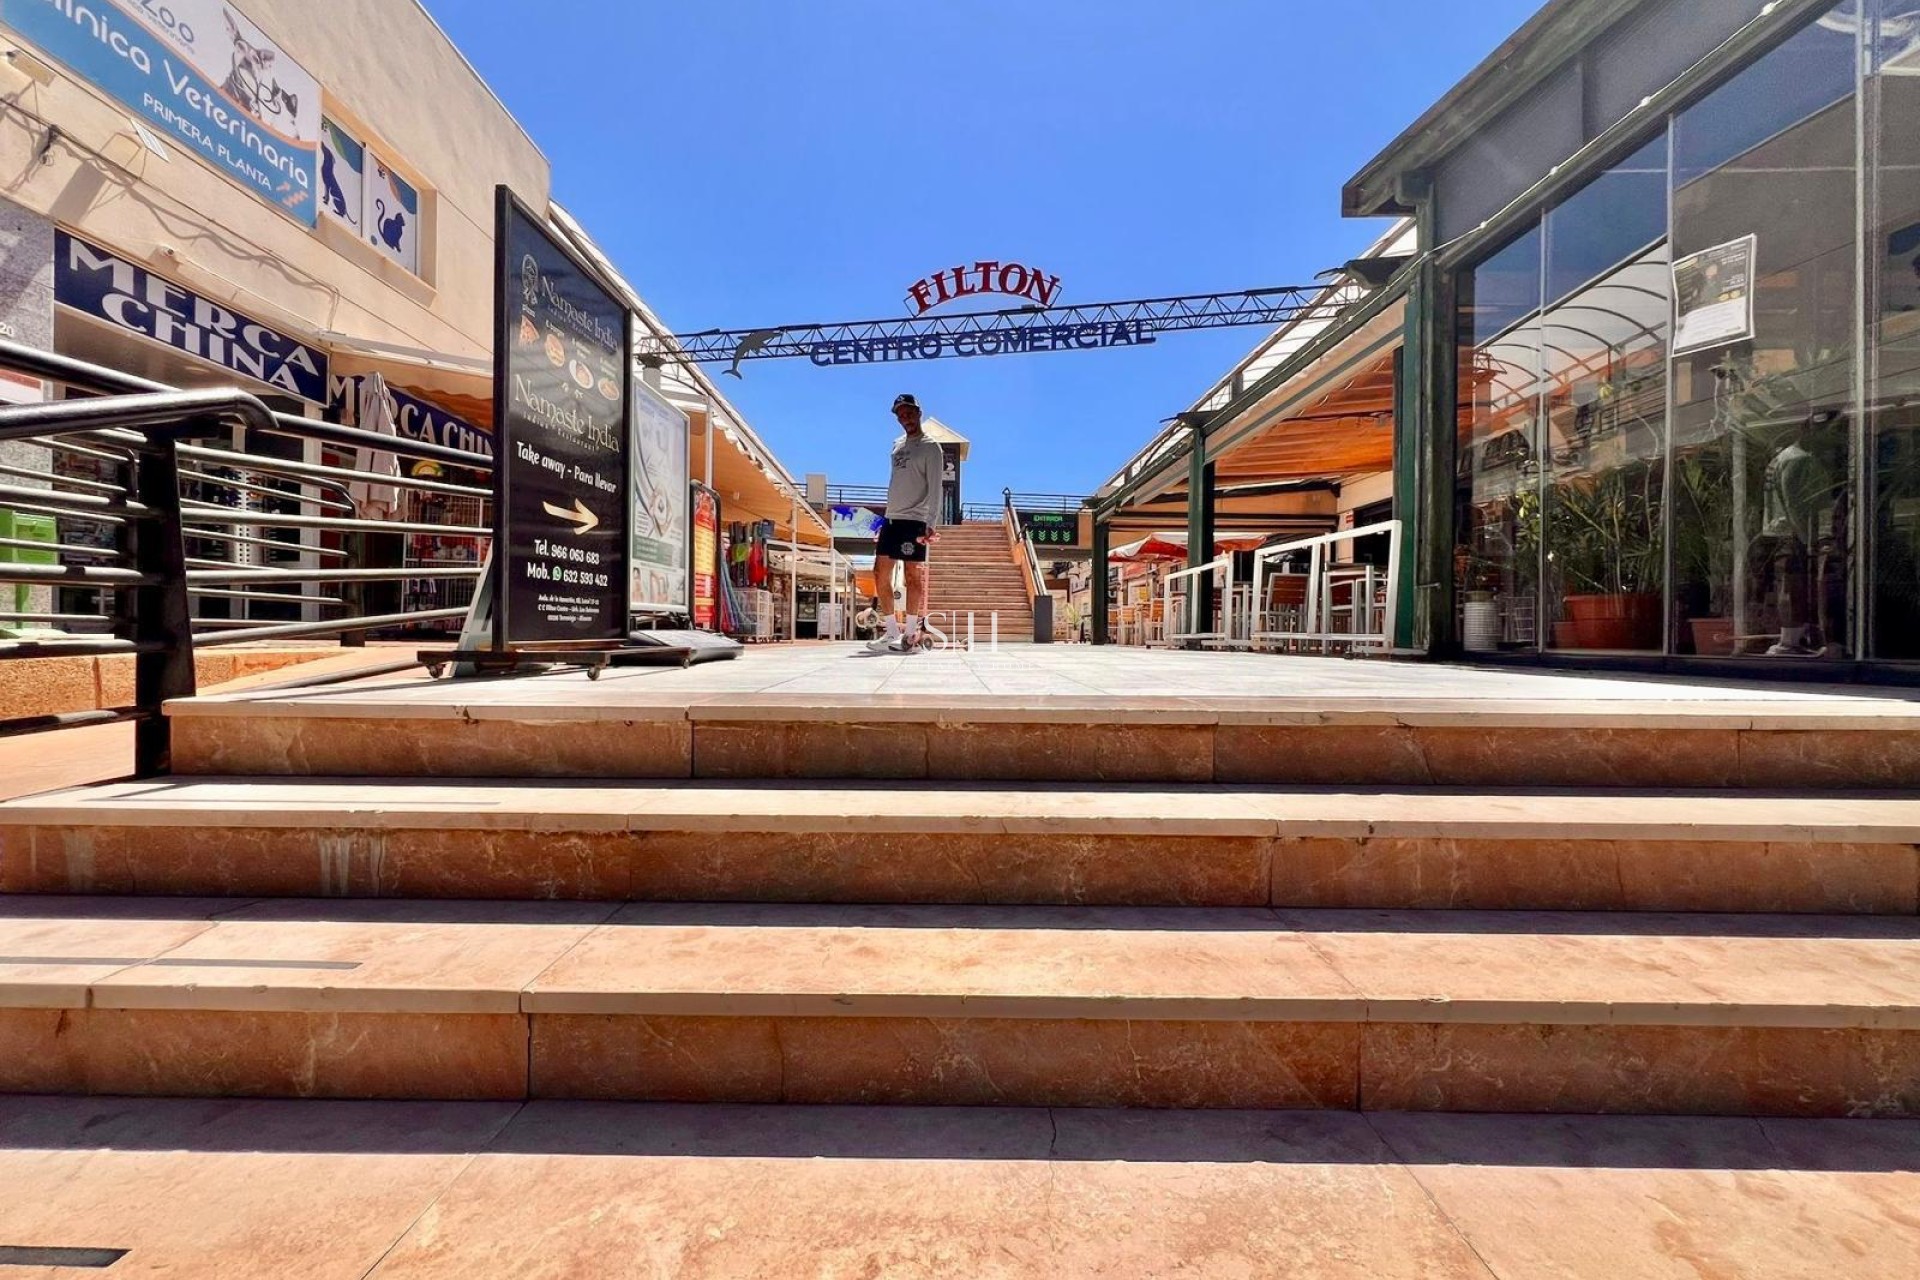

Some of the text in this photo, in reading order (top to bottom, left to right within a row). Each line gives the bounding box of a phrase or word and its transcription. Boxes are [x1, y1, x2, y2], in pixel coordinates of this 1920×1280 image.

[143, 92, 272, 191] PRIMERA PLANTA
[163, 58, 309, 189] Veterinaria
[70, 237, 319, 377] MERCA
[541, 275, 594, 334] Namaste
[907, 261, 1061, 314] FILTON
[101, 293, 301, 395] CHINA
[810, 316, 1156, 367] CENTRO COMERCIAL
[515, 373, 585, 435] Namaste
[587, 415, 620, 454] India
[516, 440, 540, 466] Take
[541, 455, 566, 479] away
[574, 464, 594, 486] Para
[594, 472, 617, 493] llevar
[527, 561, 550, 580] Mob.
[534, 538, 549, 556] Tel.
